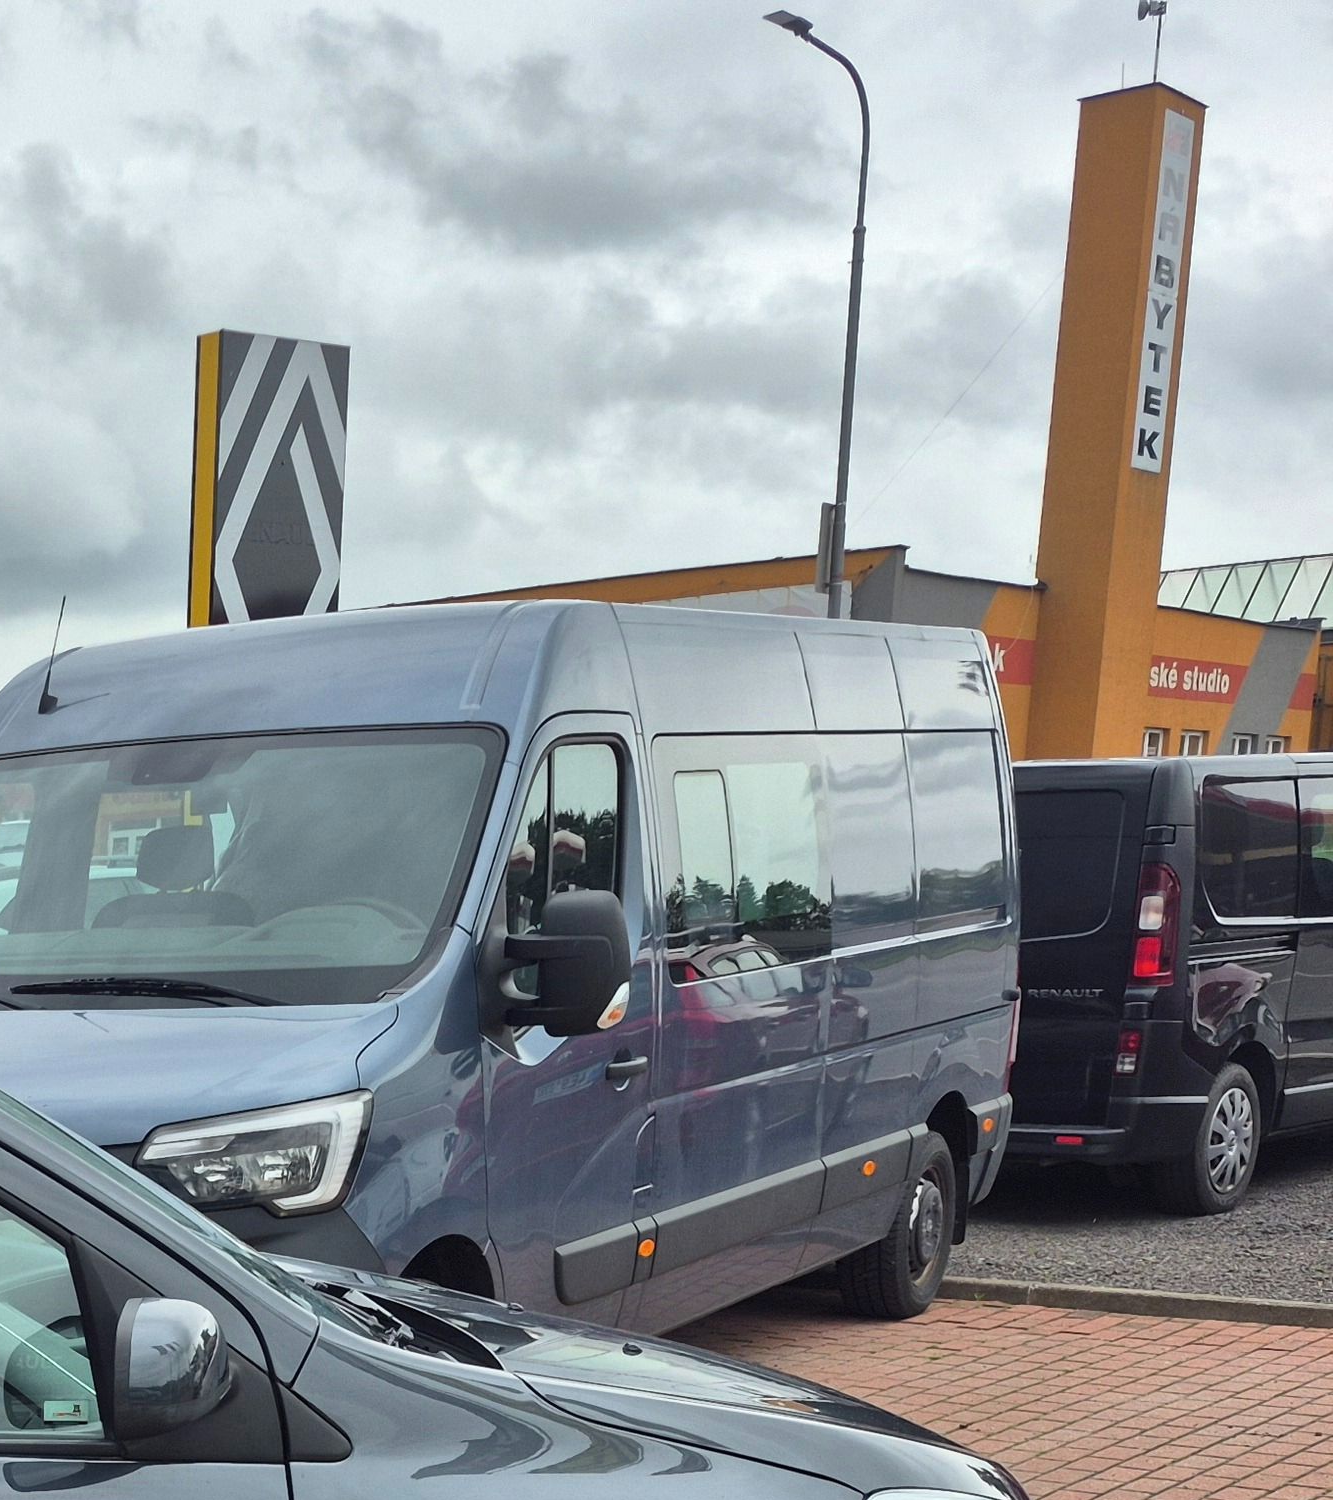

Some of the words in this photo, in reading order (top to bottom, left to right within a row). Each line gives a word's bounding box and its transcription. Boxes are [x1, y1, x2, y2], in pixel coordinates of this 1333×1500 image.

[1137, 167, 1186, 460] NÁBYTEK
[1182, 665, 1230, 694] studio
[1028, 988, 1104, 998] RENAULT
